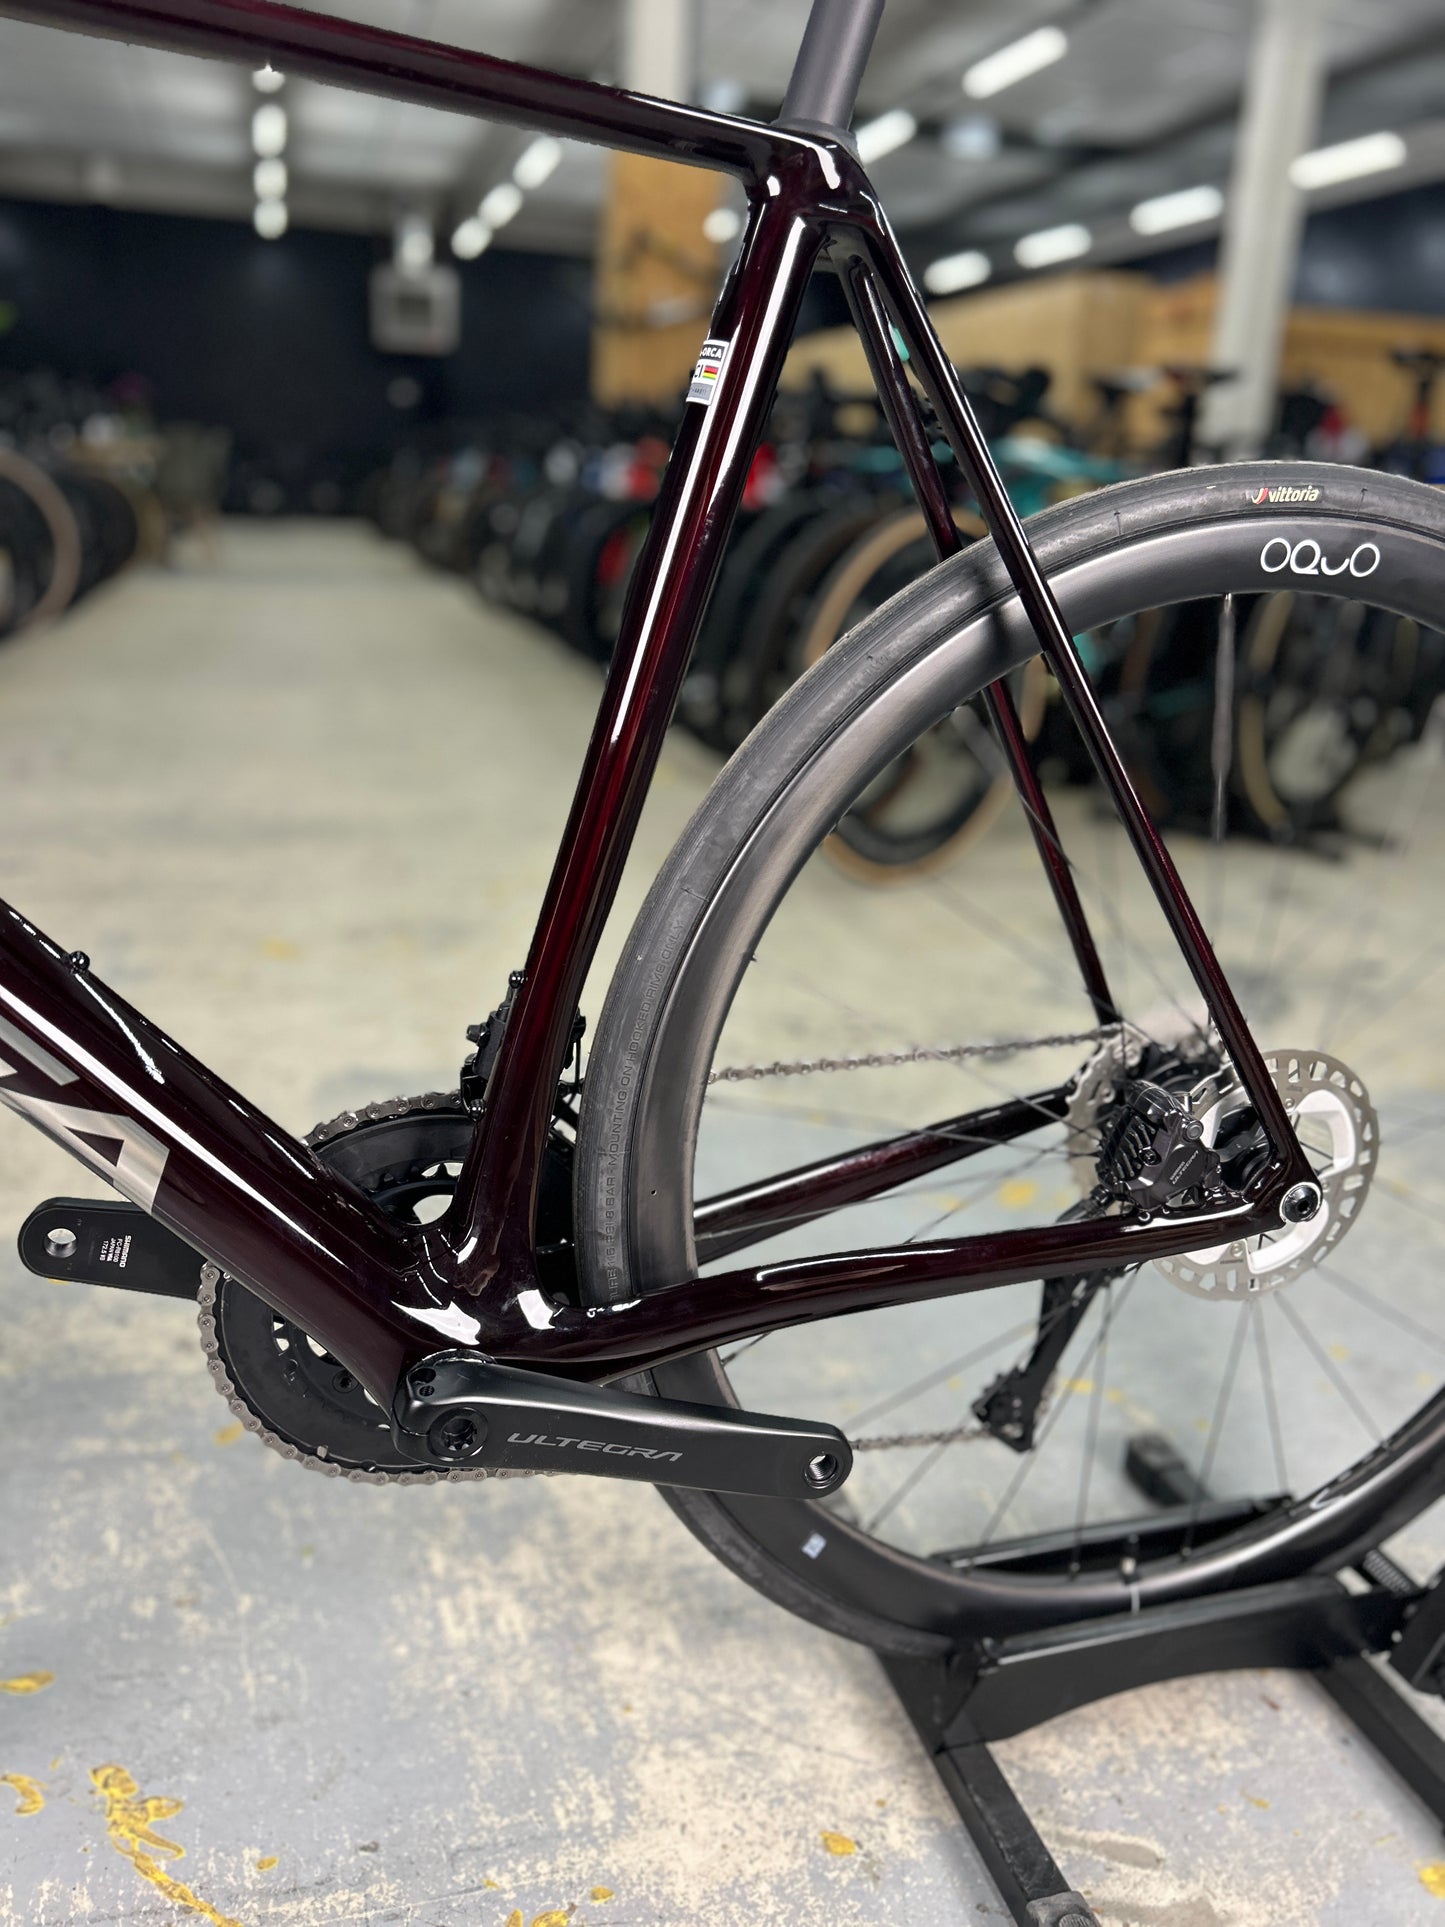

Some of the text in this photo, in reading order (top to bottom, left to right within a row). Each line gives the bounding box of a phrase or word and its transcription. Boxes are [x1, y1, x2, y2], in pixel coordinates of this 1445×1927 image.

[1268, 486, 1320, 503] vittoria
[661, 920, 685, 961] ONLY
[646, 964, 666, 1000] RIMS
[626, 1002, 651, 1062] HOOKED
[620, 1066, 633, 1087] ON
[608, 1088, 627, 1167] MOUNTING
[605, 1175, 616, 1207] BAR
[119, 1235, 132, 1268] SHIMANO
[507, 1432, 683, 1463] ULTEGRA
